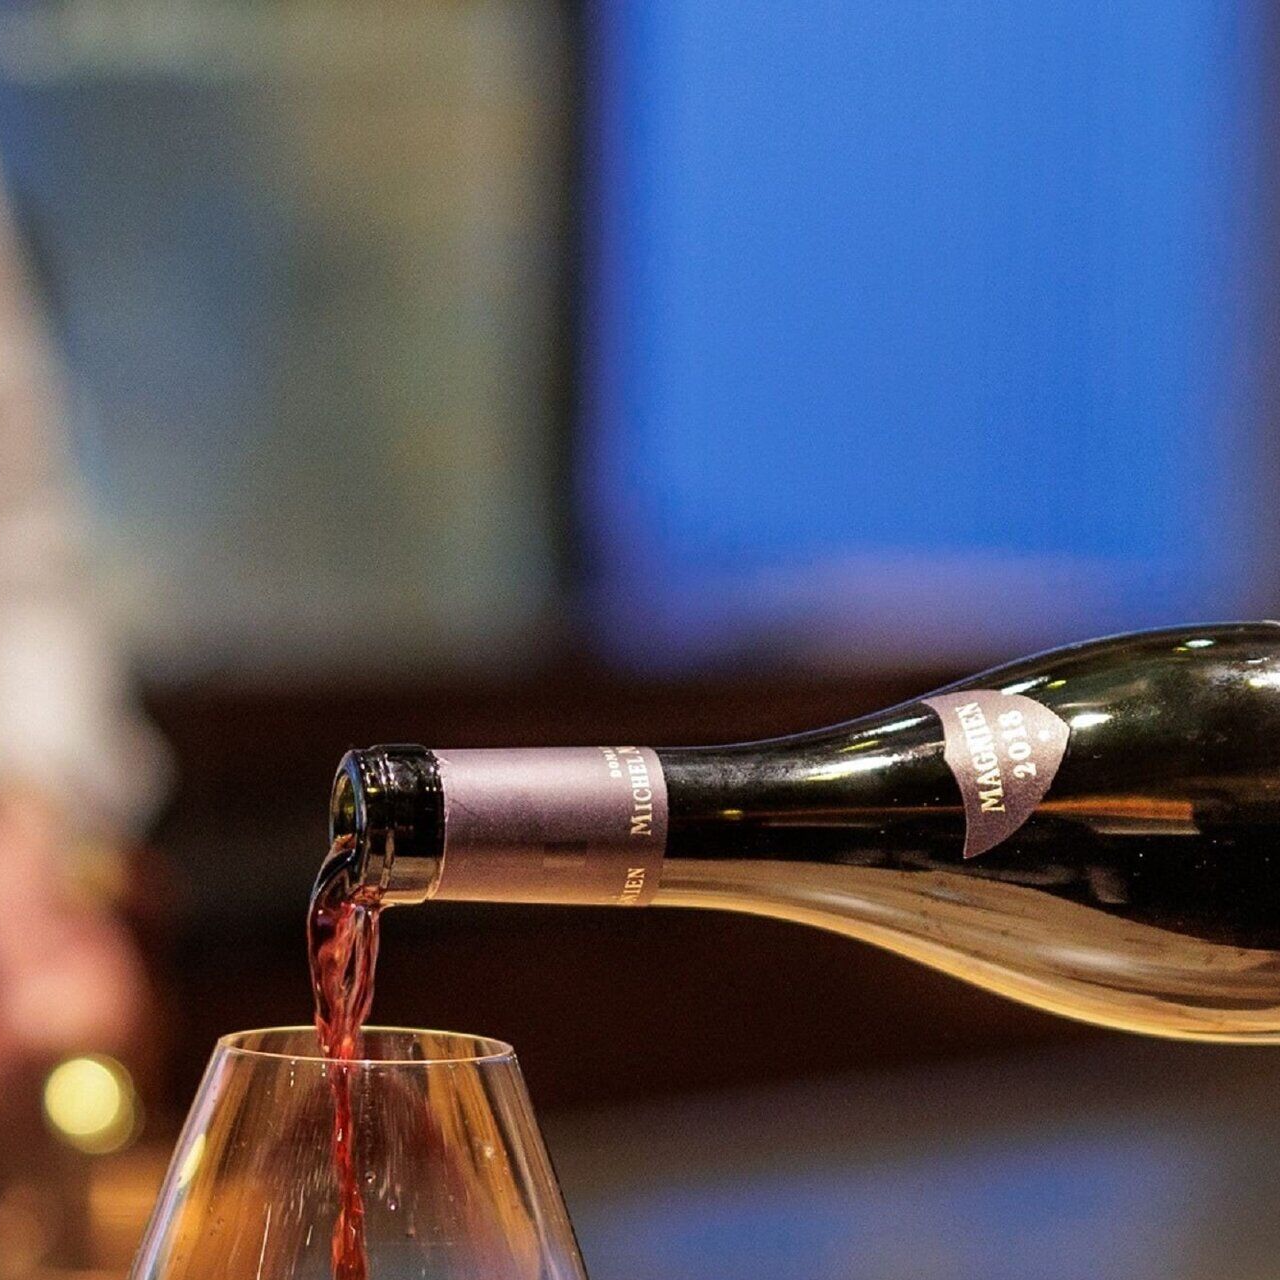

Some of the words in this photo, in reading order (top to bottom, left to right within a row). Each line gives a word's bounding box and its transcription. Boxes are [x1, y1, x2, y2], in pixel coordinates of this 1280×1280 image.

[955, 702, 1006, 813] MAGNIEN
[997, 710, 1037, 779] 2018
[627, 755, 653, 836] MICHEL
